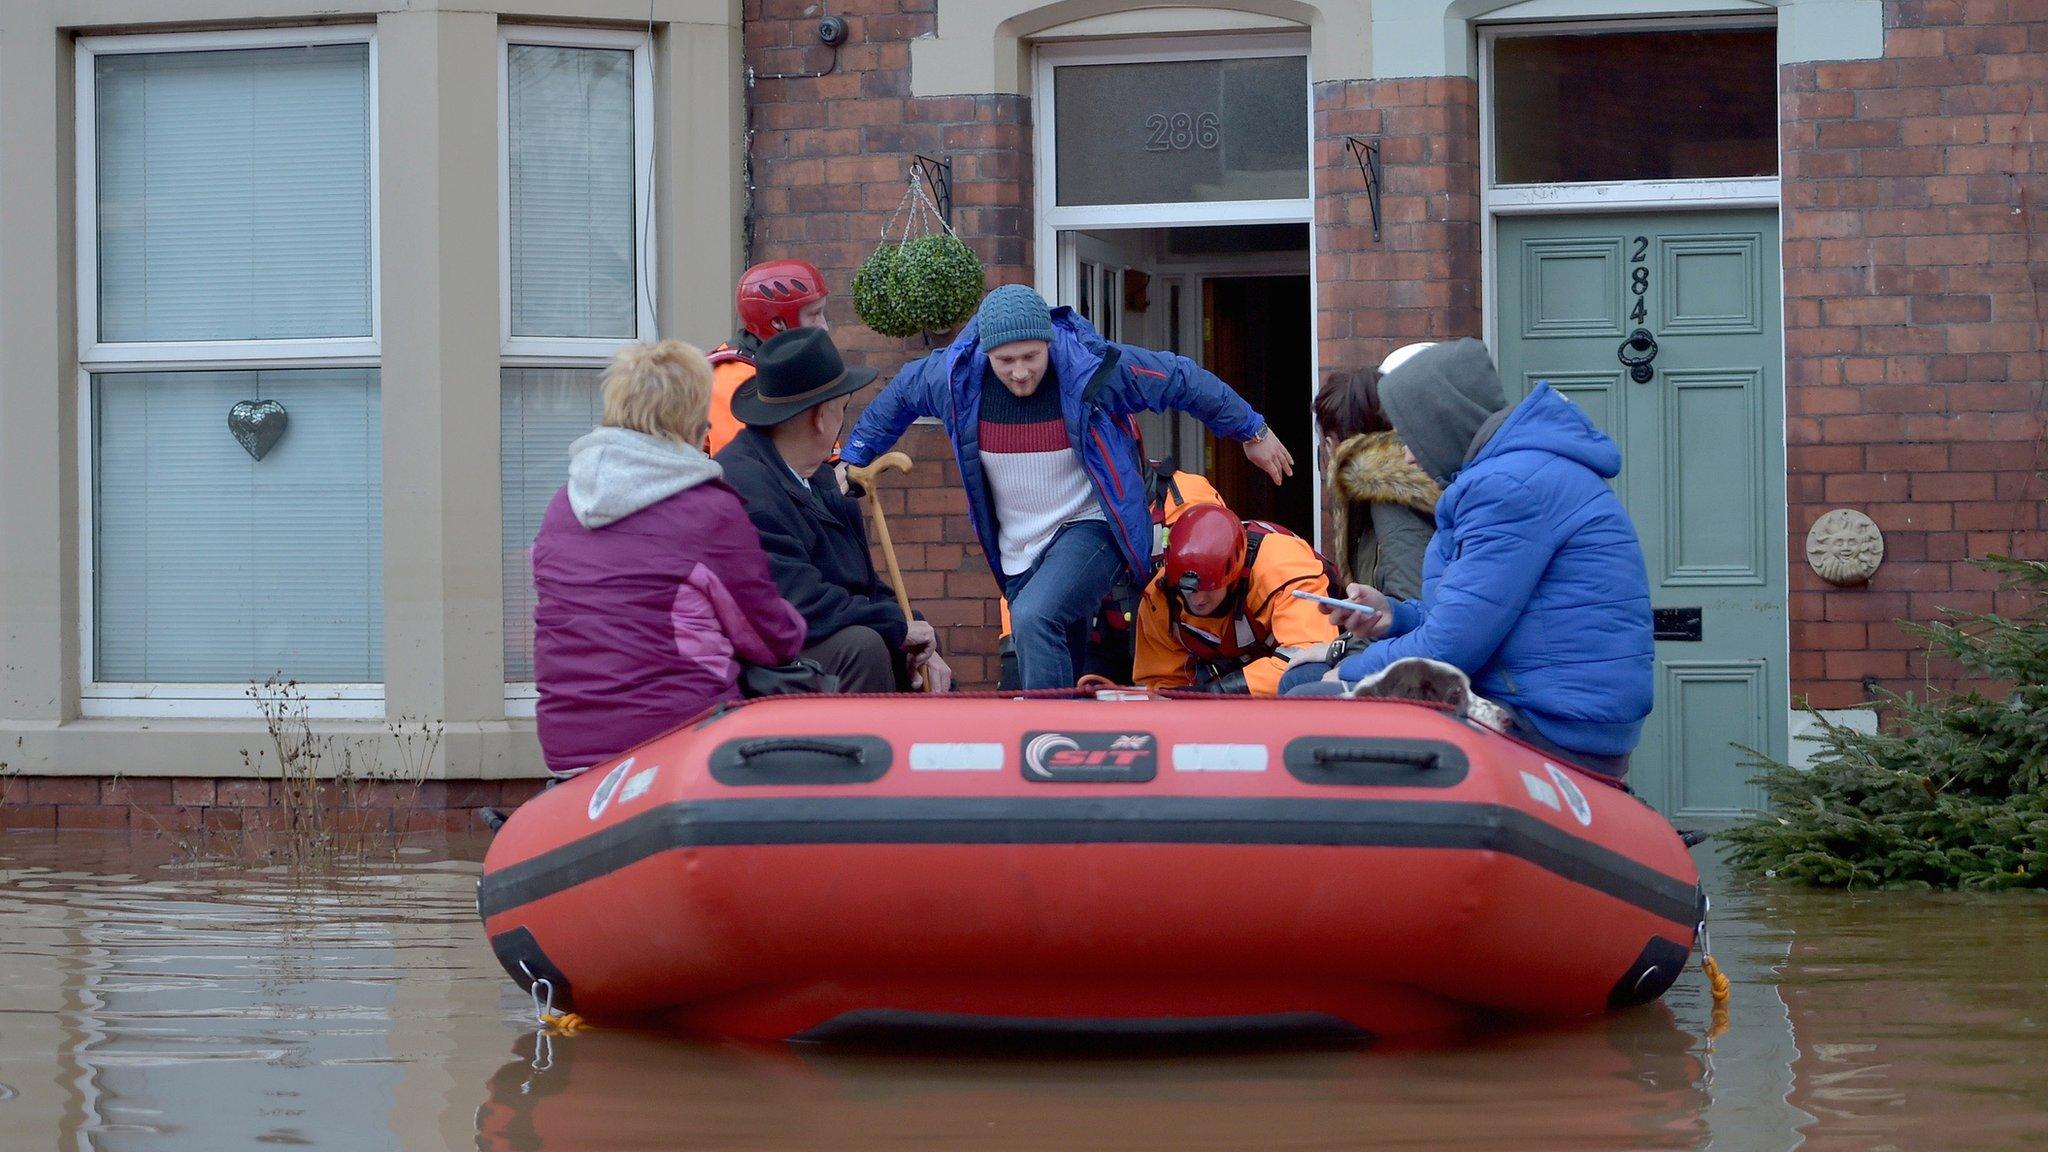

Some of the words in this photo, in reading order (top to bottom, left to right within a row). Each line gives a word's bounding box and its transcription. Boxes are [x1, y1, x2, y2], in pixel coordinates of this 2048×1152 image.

[1144, 112, 1220, 151] 286
[1629, 235, 1650, 325] 284
[1047, 749, 1150, 766] SIT
